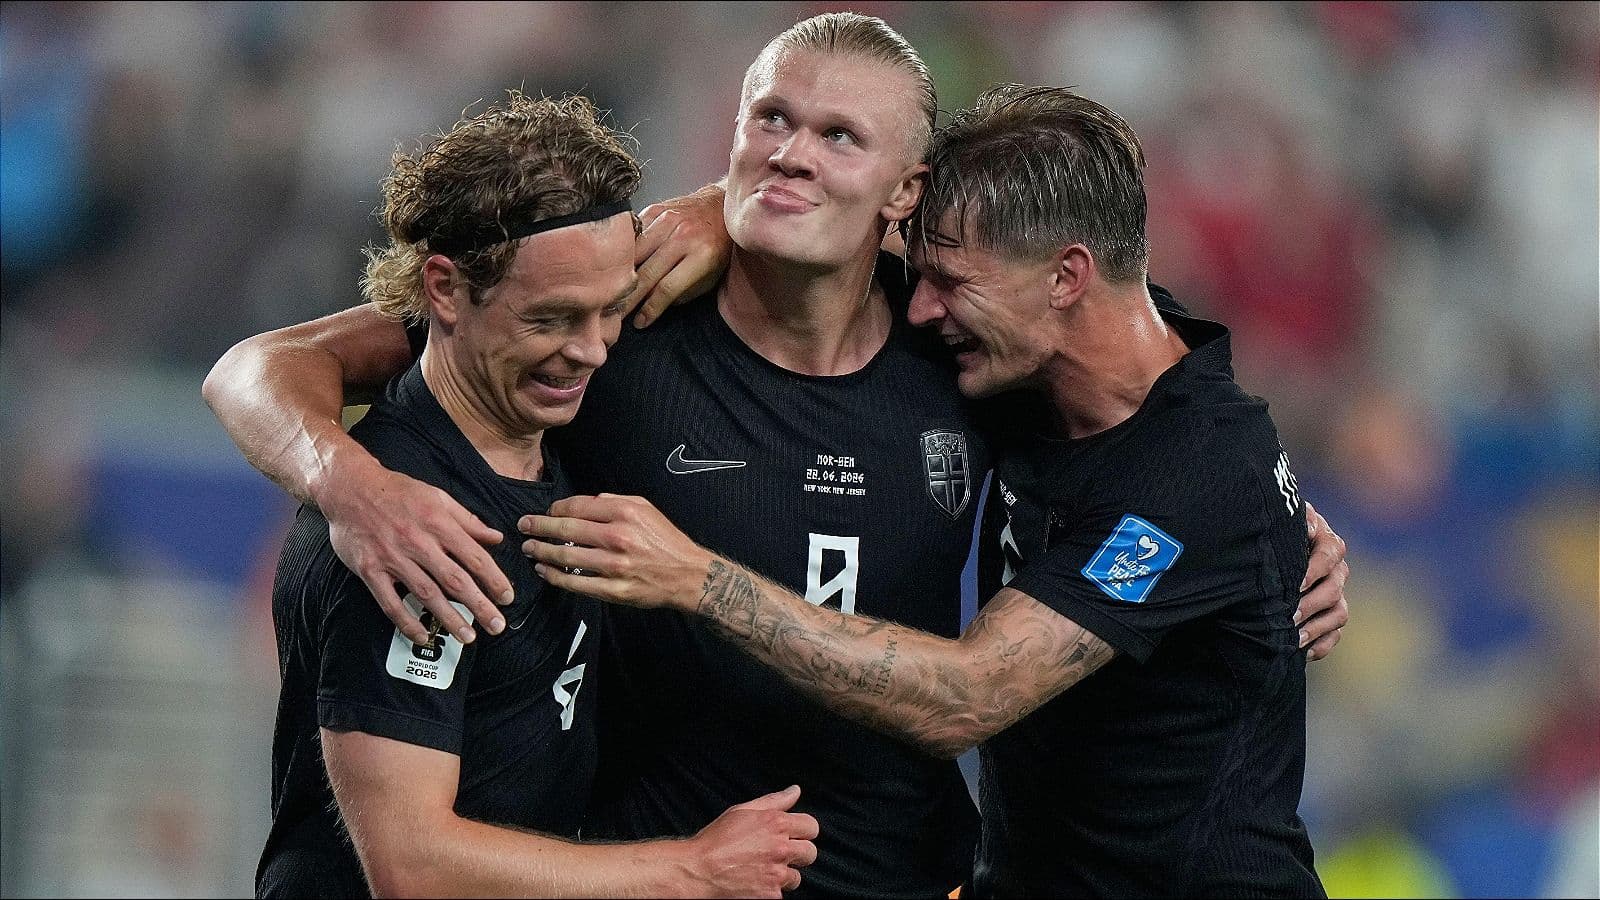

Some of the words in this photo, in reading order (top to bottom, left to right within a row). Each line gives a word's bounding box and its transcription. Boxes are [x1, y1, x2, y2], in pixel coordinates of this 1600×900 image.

[803, 483, 816, 492] NEW
[832, 486, 845, 495] NEW
[846, 488, 866, 496] JERSEY
[420, 648, 434, 658] FIFA
[408, 659, 429, 669] WORLD
[405, 666, 438, 680] 2026
